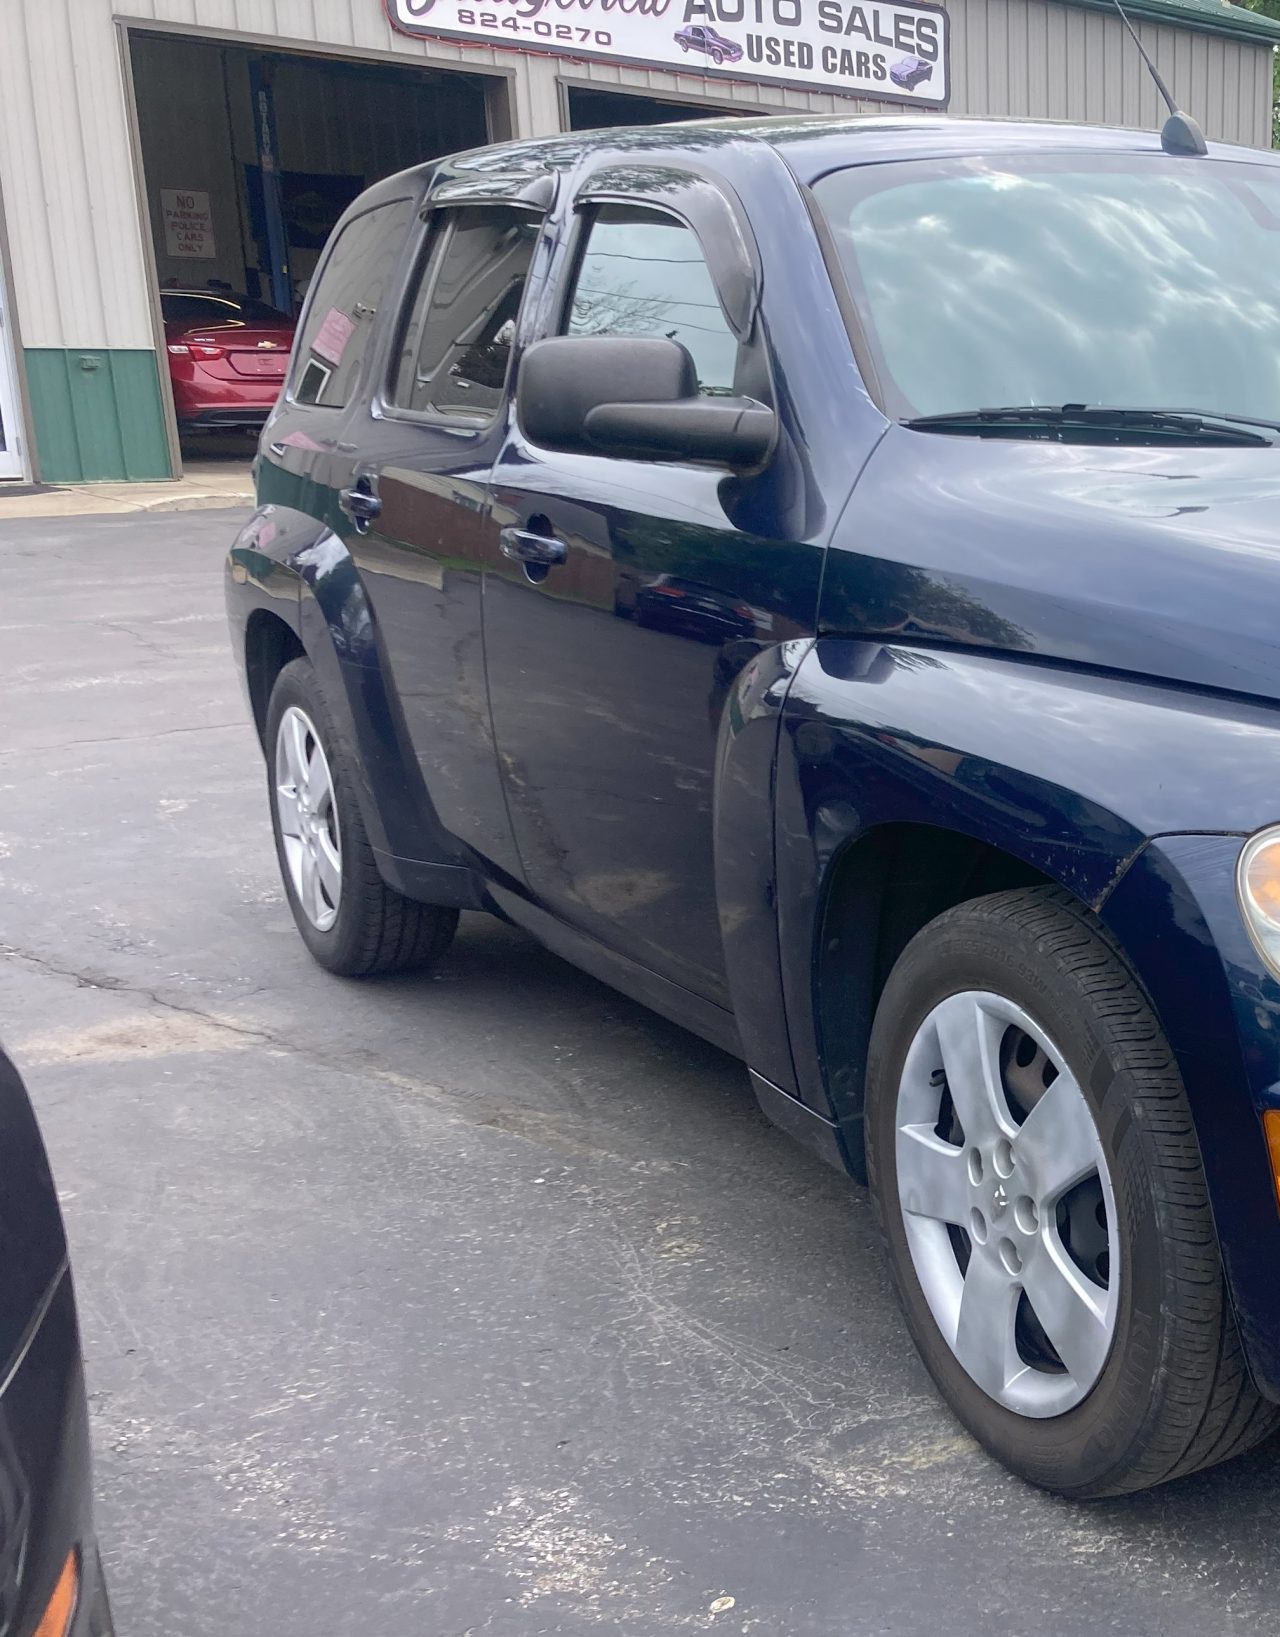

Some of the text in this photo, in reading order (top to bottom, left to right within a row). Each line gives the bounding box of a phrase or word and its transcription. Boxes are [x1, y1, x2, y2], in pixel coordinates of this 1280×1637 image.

[457, 9, 612, 46] 824-0270
[818, 0, 939, 63] SALES
[746, 33, 888, 81] USED CARS
[176, 195, 195, 209] NO
[178, 243, 203, 253] ONLY
